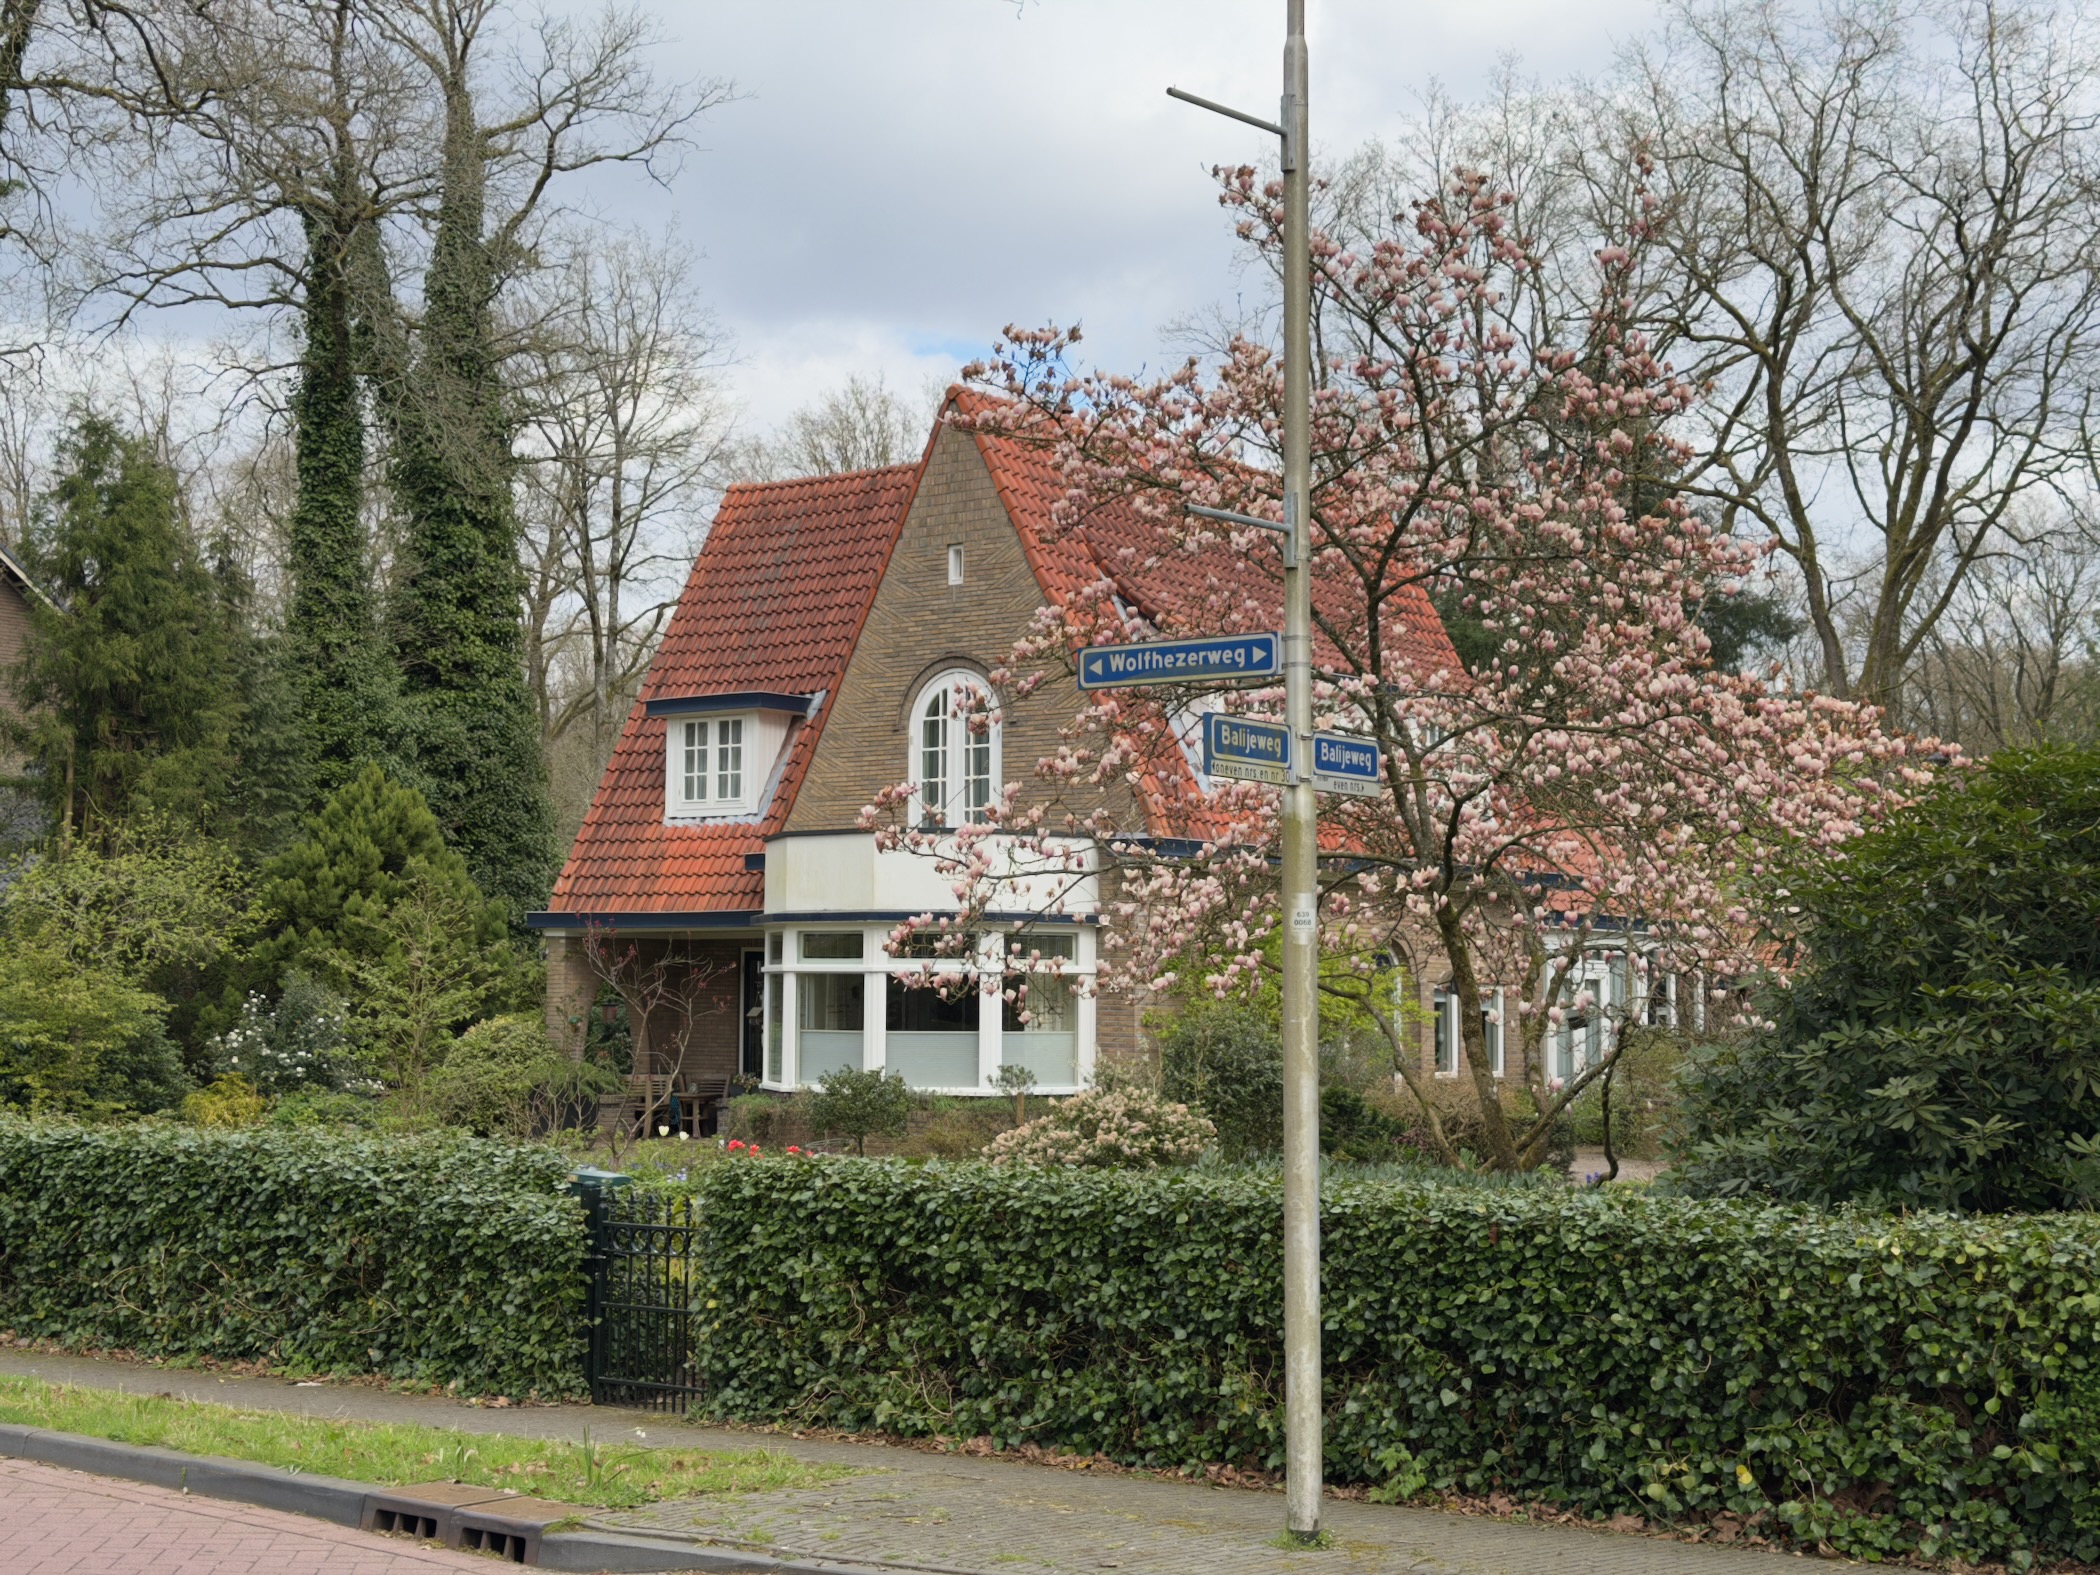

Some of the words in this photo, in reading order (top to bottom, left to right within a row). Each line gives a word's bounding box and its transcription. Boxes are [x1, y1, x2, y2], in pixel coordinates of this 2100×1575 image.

[1109, 647, 1245, 673] Wolfhezerweg
[1221, 724, 1282, 758] Balijeweg
[1320, 741, 1372, 772] Balijeweg
[1215, 763, 1243, 776] oneven
[1270, 771, 1279, 781] nr
[1281, 769, 1291, 783] 30
[1333, 780, 1348, 791] even
